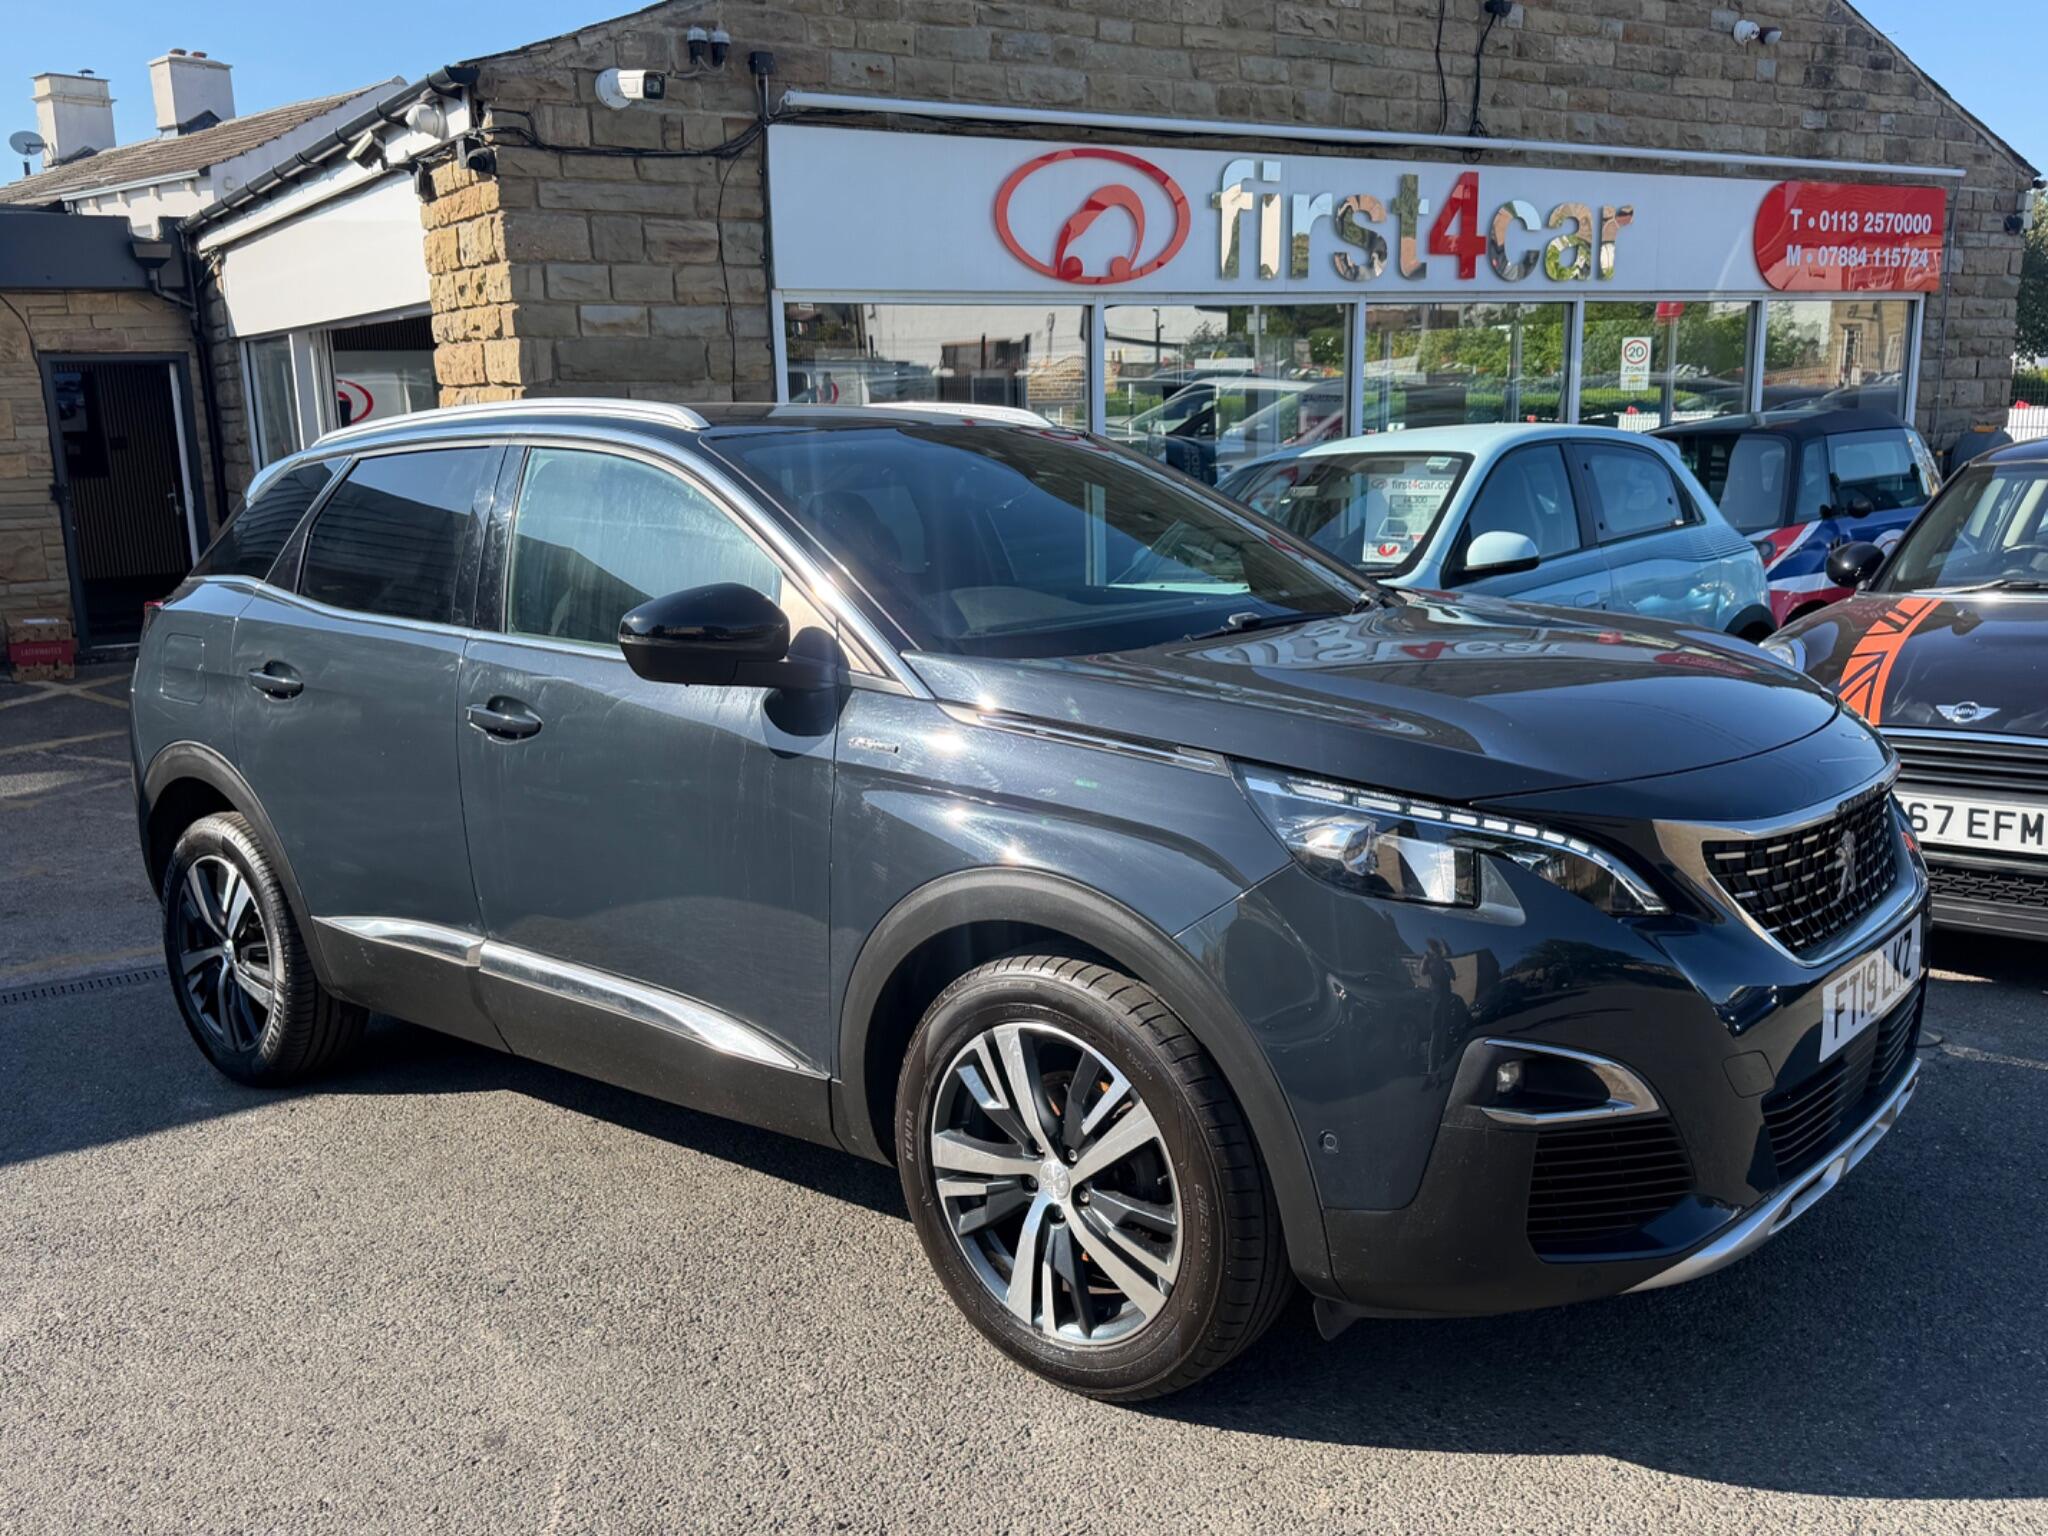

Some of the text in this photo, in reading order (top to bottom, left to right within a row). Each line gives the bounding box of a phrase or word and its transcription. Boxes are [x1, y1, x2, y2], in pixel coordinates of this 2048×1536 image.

[1211, 158, 1634, 282] first4car
[1789, 208, 1932, 234] T 0113 2570000
[1786, 244, 1929, 269] M 07884 115724
[1628, 346, 1645, 358] 20
[1967, 807, 2045, 846] EFM
[1834, 928, 1913, 1041] FT19 LKZ
